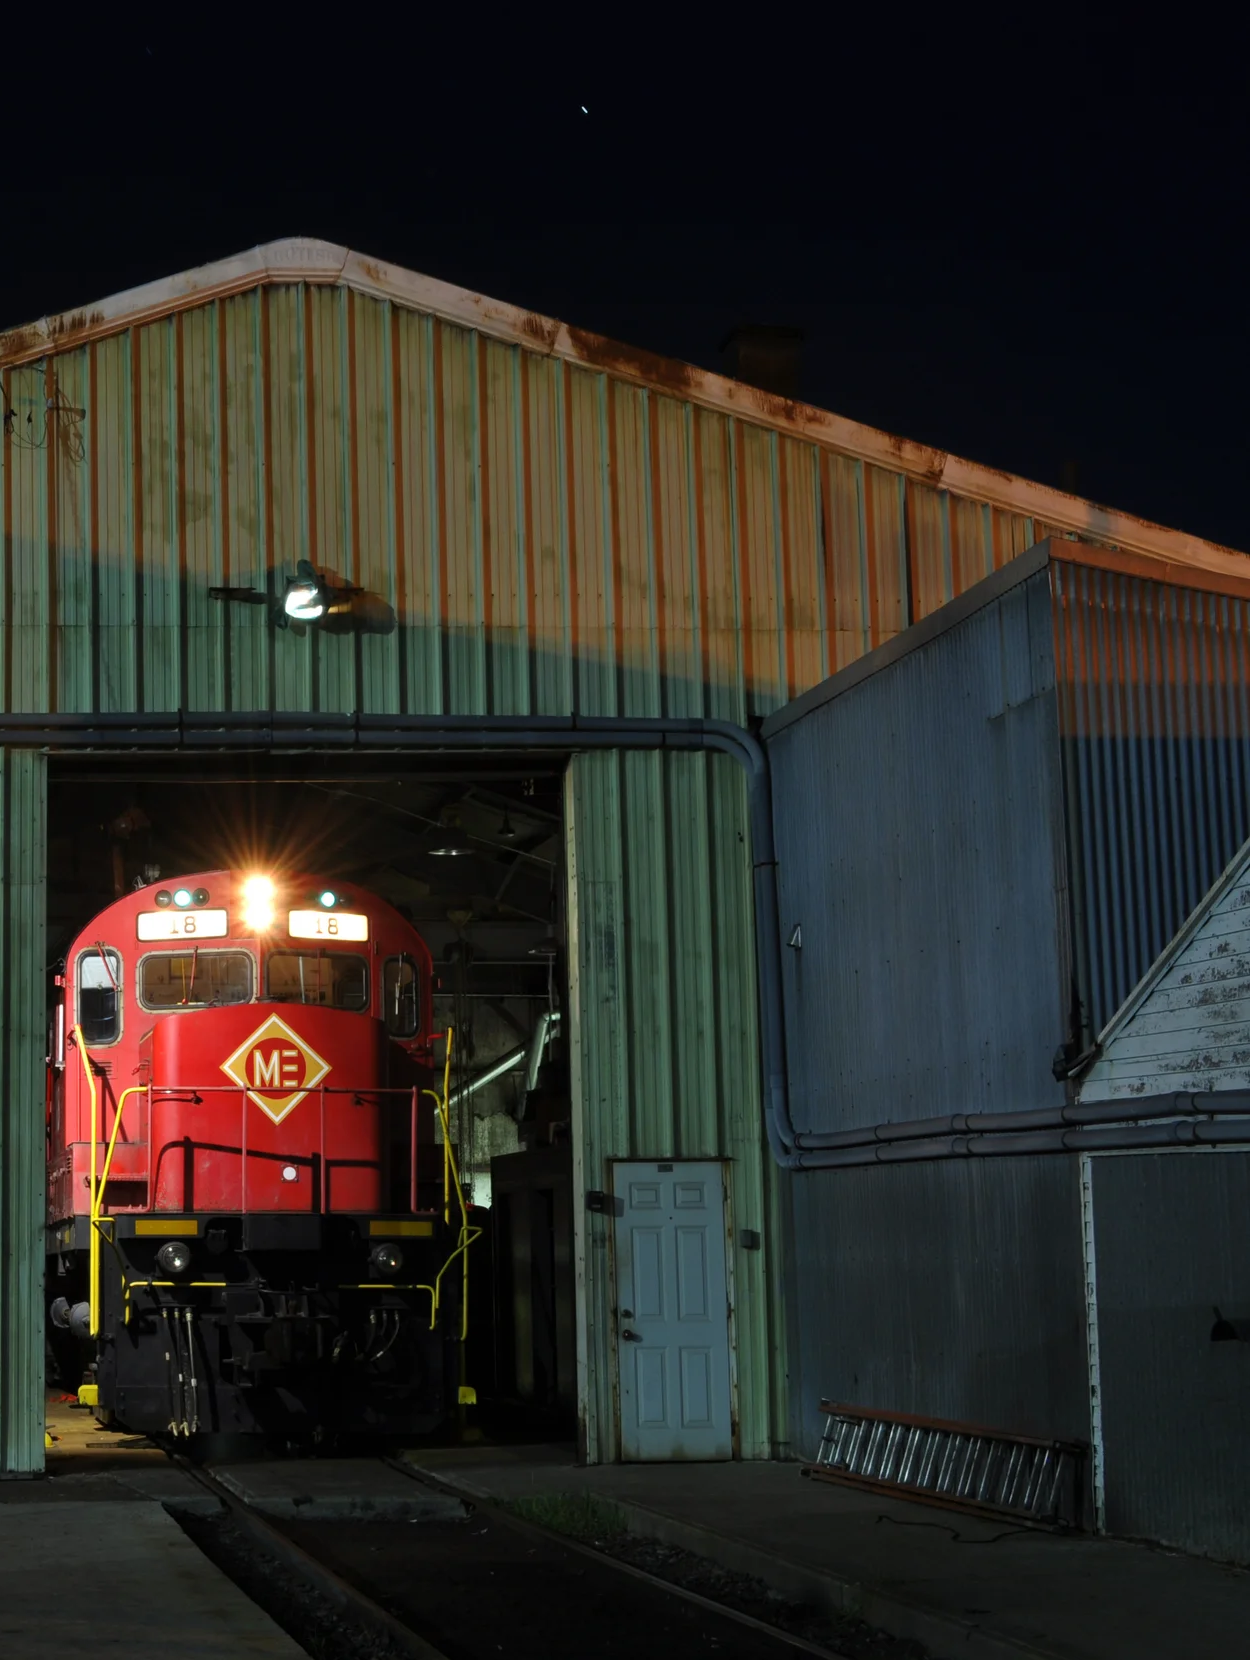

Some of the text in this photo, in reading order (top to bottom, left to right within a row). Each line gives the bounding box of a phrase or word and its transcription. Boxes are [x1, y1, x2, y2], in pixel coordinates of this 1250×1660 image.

[170, 915, 196, 935] 18
[315, 917, 339, 935] 18
[253, 1049, 299, 1087] ME
